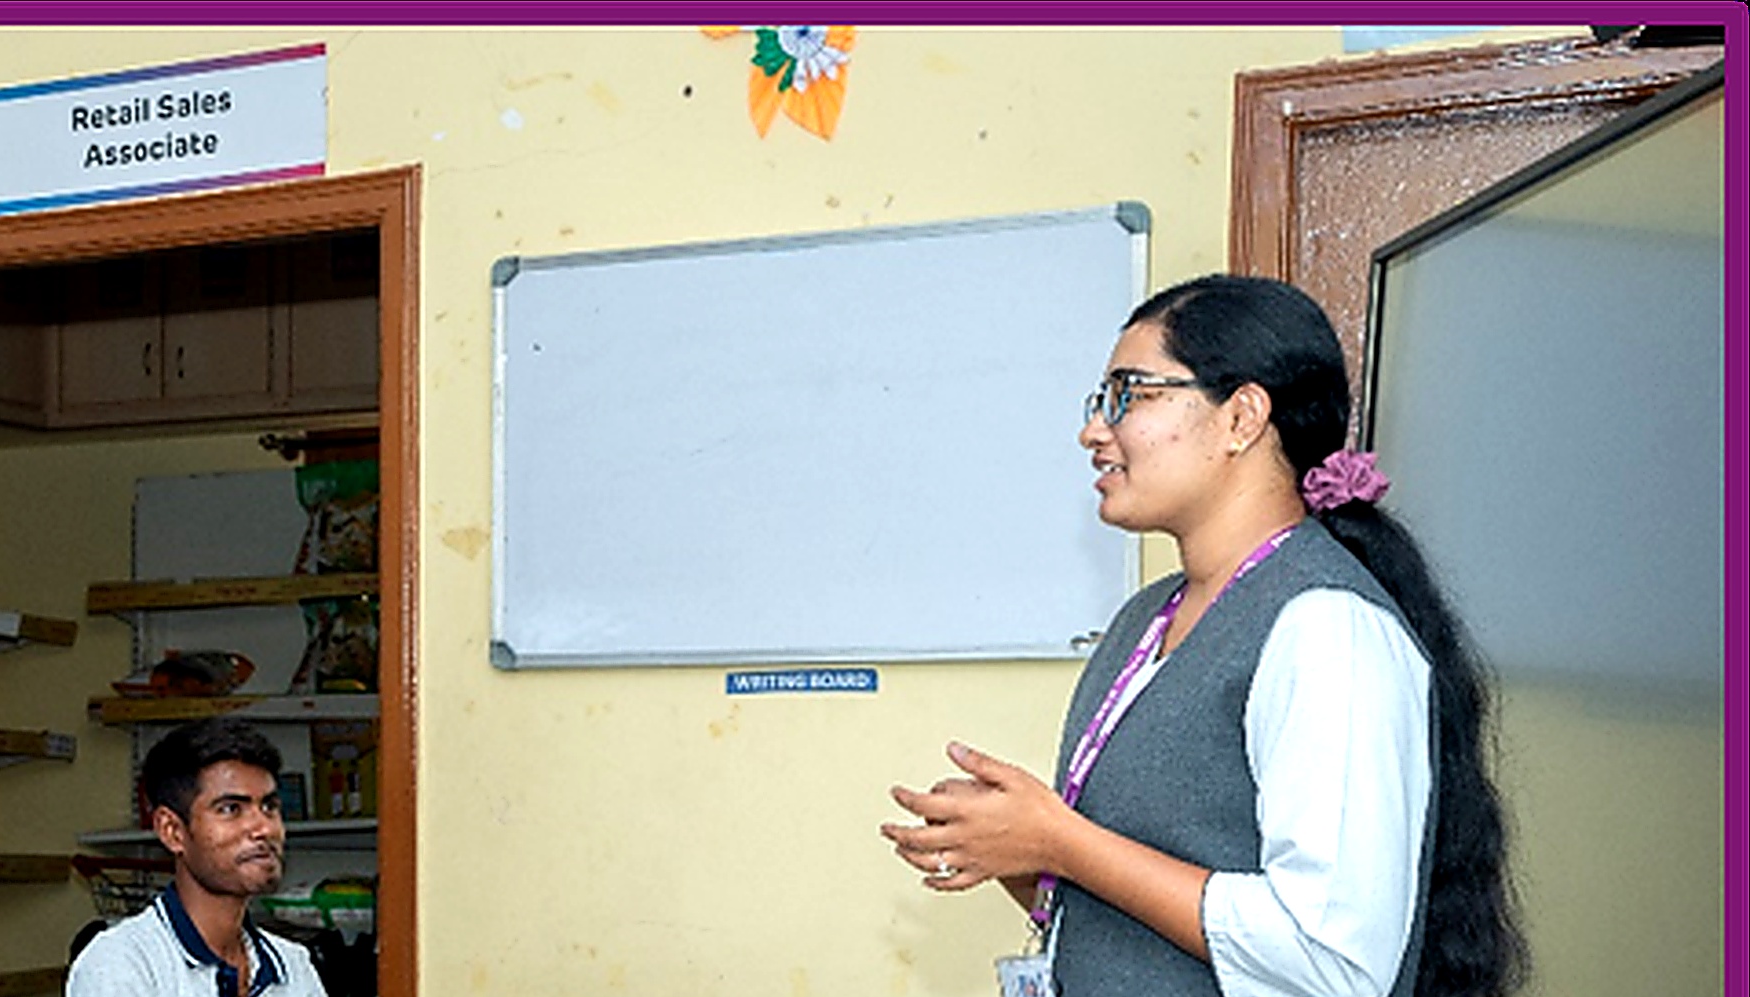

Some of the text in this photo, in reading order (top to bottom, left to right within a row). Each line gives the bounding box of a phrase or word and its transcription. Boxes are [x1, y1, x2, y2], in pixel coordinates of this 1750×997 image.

[72, 91, 232, 131] Retail Sales
[84, 131, 218, 168] Associate
[734, 671, 870, 691] WRITING BOARD
